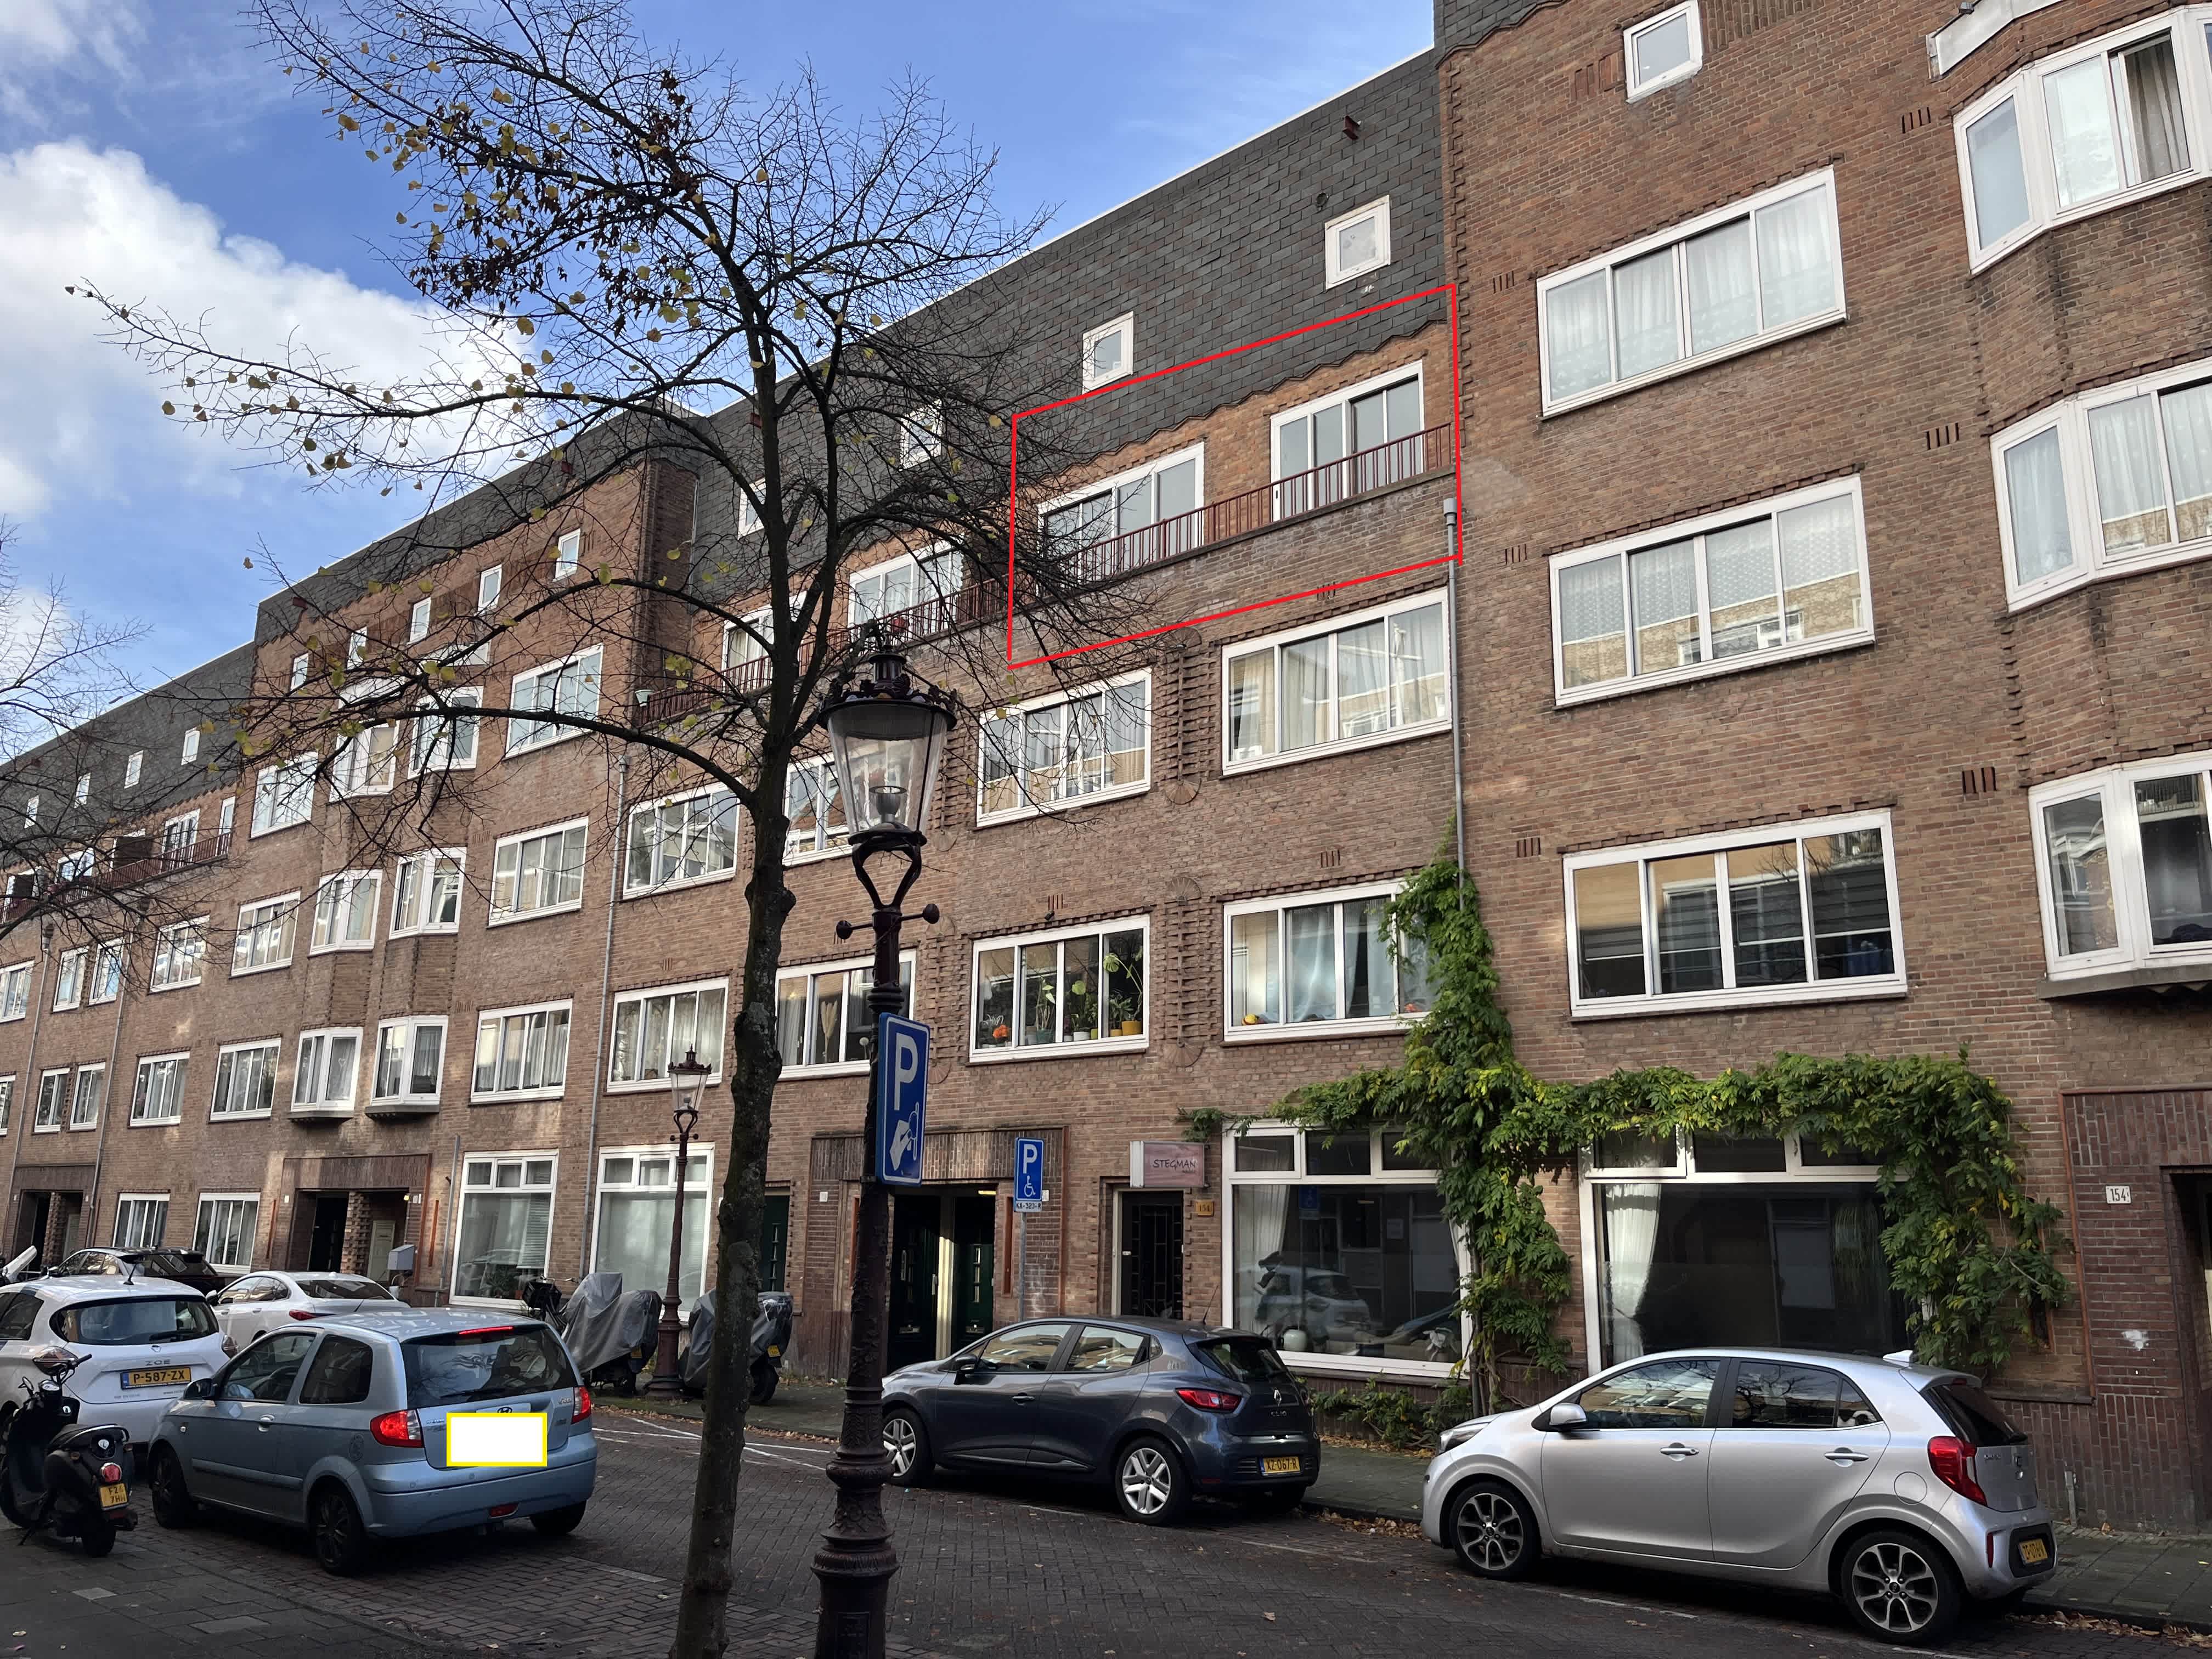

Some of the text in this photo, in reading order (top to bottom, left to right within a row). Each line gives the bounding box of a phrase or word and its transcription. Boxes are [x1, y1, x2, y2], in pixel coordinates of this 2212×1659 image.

[894, 1032, 918, 1111] P
[1023, 1143, 1038, 1174] P
[1153, 1159, 1196, 1170] STEGMAN
[133, 1370, 185, 1383] P-587-ZX
[1266, 1458, 1298, 1471] XZ-067-R
